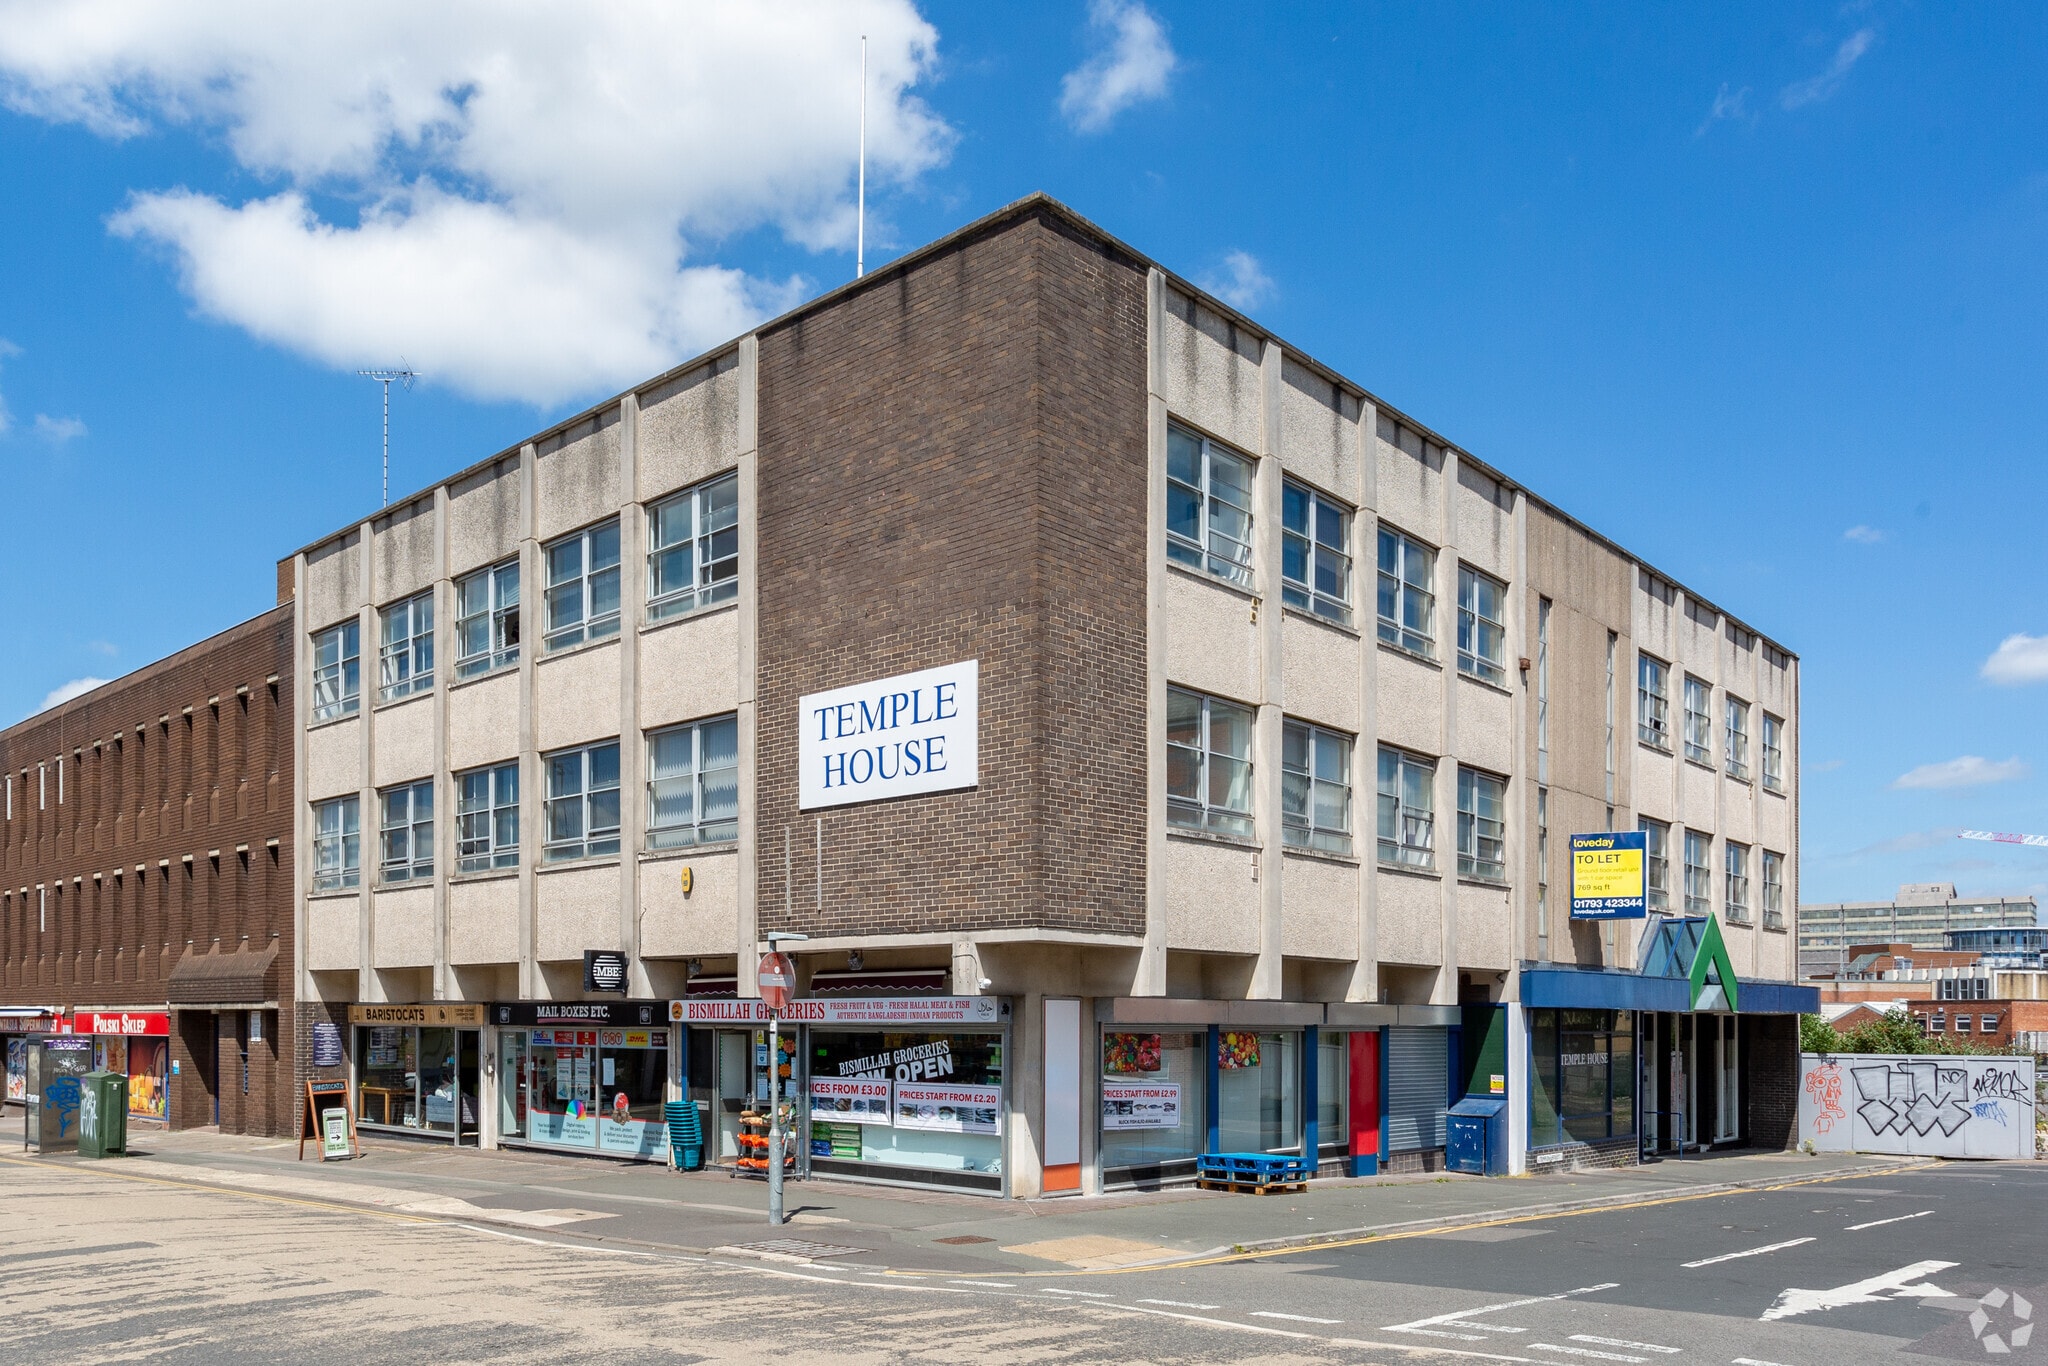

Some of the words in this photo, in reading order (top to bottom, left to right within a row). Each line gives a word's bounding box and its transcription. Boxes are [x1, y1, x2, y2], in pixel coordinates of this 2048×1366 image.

[813, 682, 958, 741] TEMPLE
[822, 735, 948, 789] HOUSE
[1573, 837, 1615, 849] loveday
[1576, 854, 1594, 864] TO
[1598, 853, 1621, 864] LET
[1573, 899, 1603, 908] 01793
[1604, 898, 1643, 908] 423344
[596, 966, 620, 977] MBE
[536, 1005, 559, 1018] MAIL
[560, 1005, 589, 1018] BOXES
[590, 1005, 611, 1018] ETC.
[688, 1003, 751, 1019] BISMILLAH
[829, 1002, 848, 1010] FRESH
[849, 1002, 865, 1010] FRUIT
[889, 1001, 908, 1009] FRESH
[909, 1001, 929, 1009] HALAL
[930, 1001, 948, 1009] MEAT
[366, 1008, 425, 1021] BARISTOCATS
[836, 1012, 867, 1020] AUTHENTIC
[931, 1010, 964, 1019] PRODUCTS
[533, 1030, 549, 1039] FedEx
[602, 1032, 622, 1045] TNT
[628, 1035, 646, 1043] DHL
[838, 1051, 891, 1076] BISMILLAH
[893, 1039, 950, 1064] GROCERIES
[1561, 1053, 1586, 1066] TEMPLE
[1587, 1052, 1609, 1065] HOUSE
[894, 1053, 954, 1083] OPEN
[809, 1083, 831, 1093] ICES
[832, 1083, 859, 1095] FROM
[861, 1084, 887, 1096] £3.00
[1103, 1089, 1123, 1098] PRICES
[1124, 1089, 1142, 1098] START
[1143, 1089, 1160, 1098] FROM
[1161, 1089, 1177, 1098] £2.99
[899, 1090, 924, 1100] PRICES
[925, 1091, 949, 1101] START
[949, 1092, 972, 1102] FROM
[973, 1094, 997, 1104] £2.20
